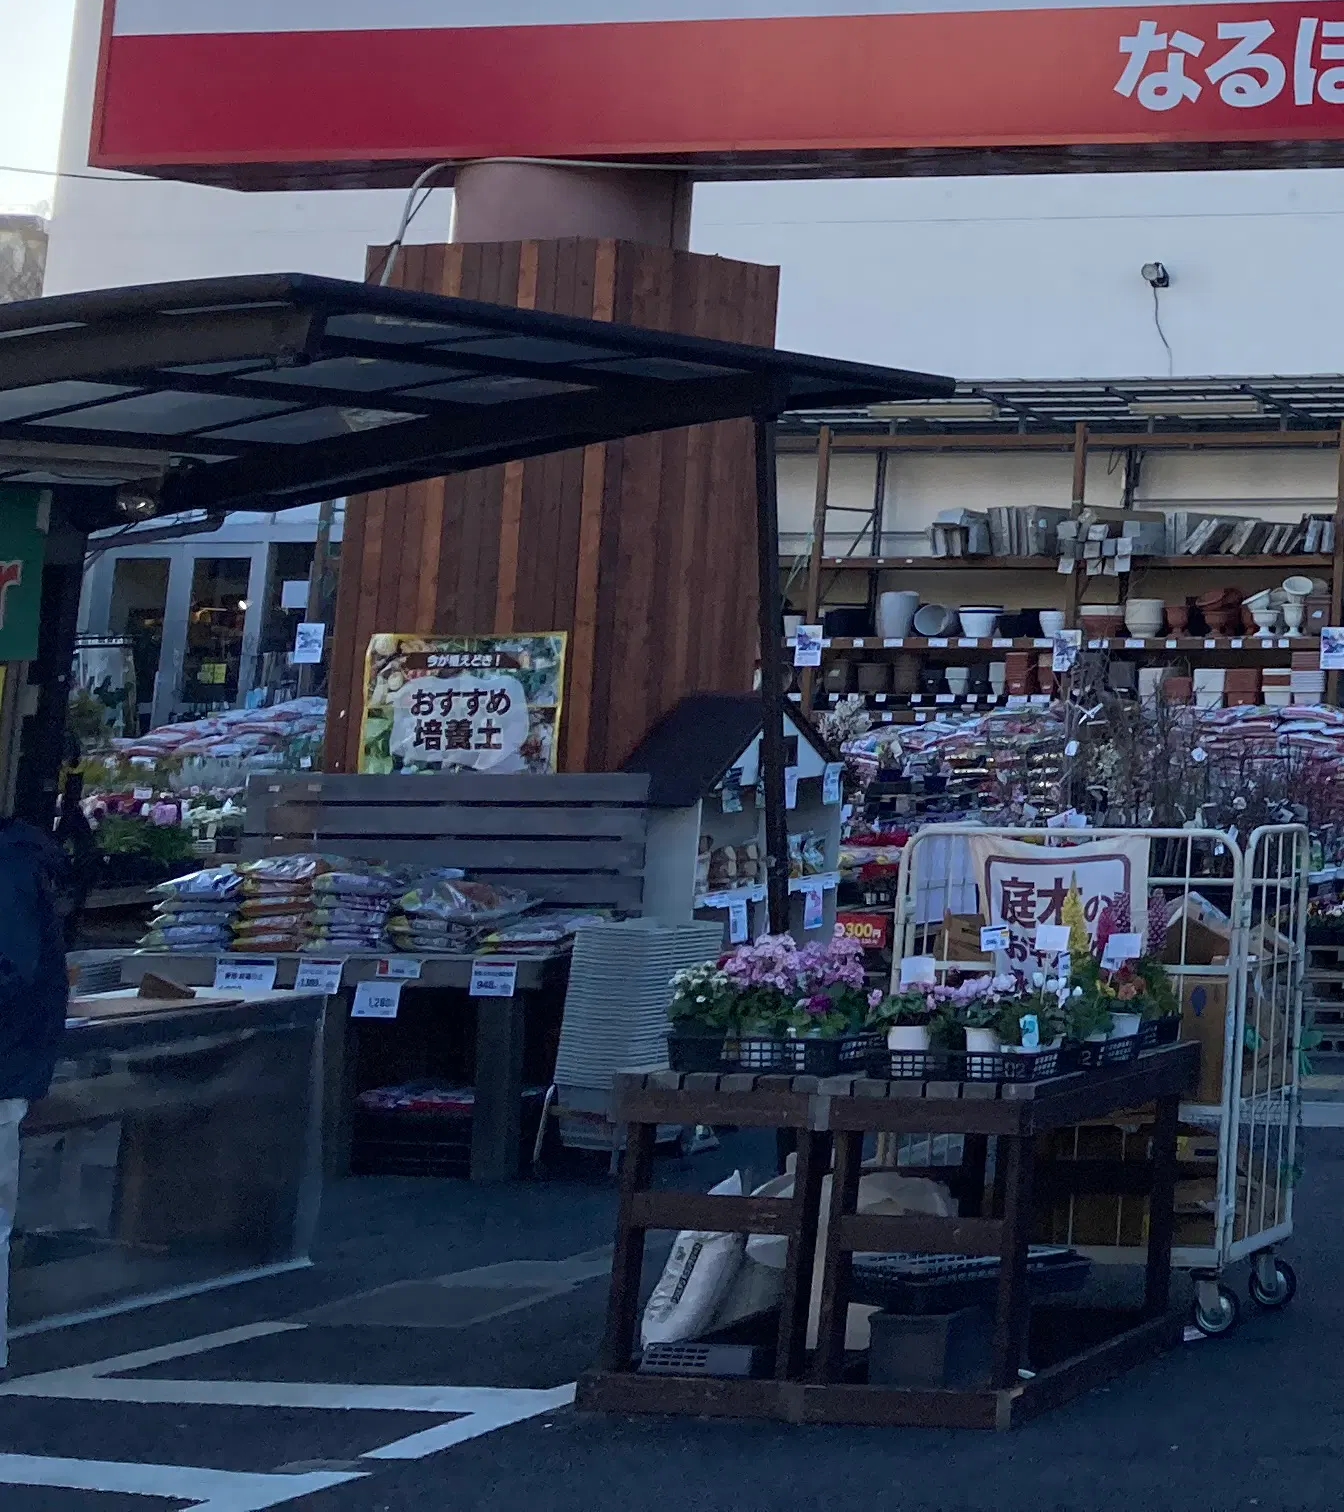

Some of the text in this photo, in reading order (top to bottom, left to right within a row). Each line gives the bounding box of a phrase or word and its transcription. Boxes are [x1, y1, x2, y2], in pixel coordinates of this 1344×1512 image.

[410, 688, 512, 718] おすすめ
[413, 718, 503, 751] 培養土
